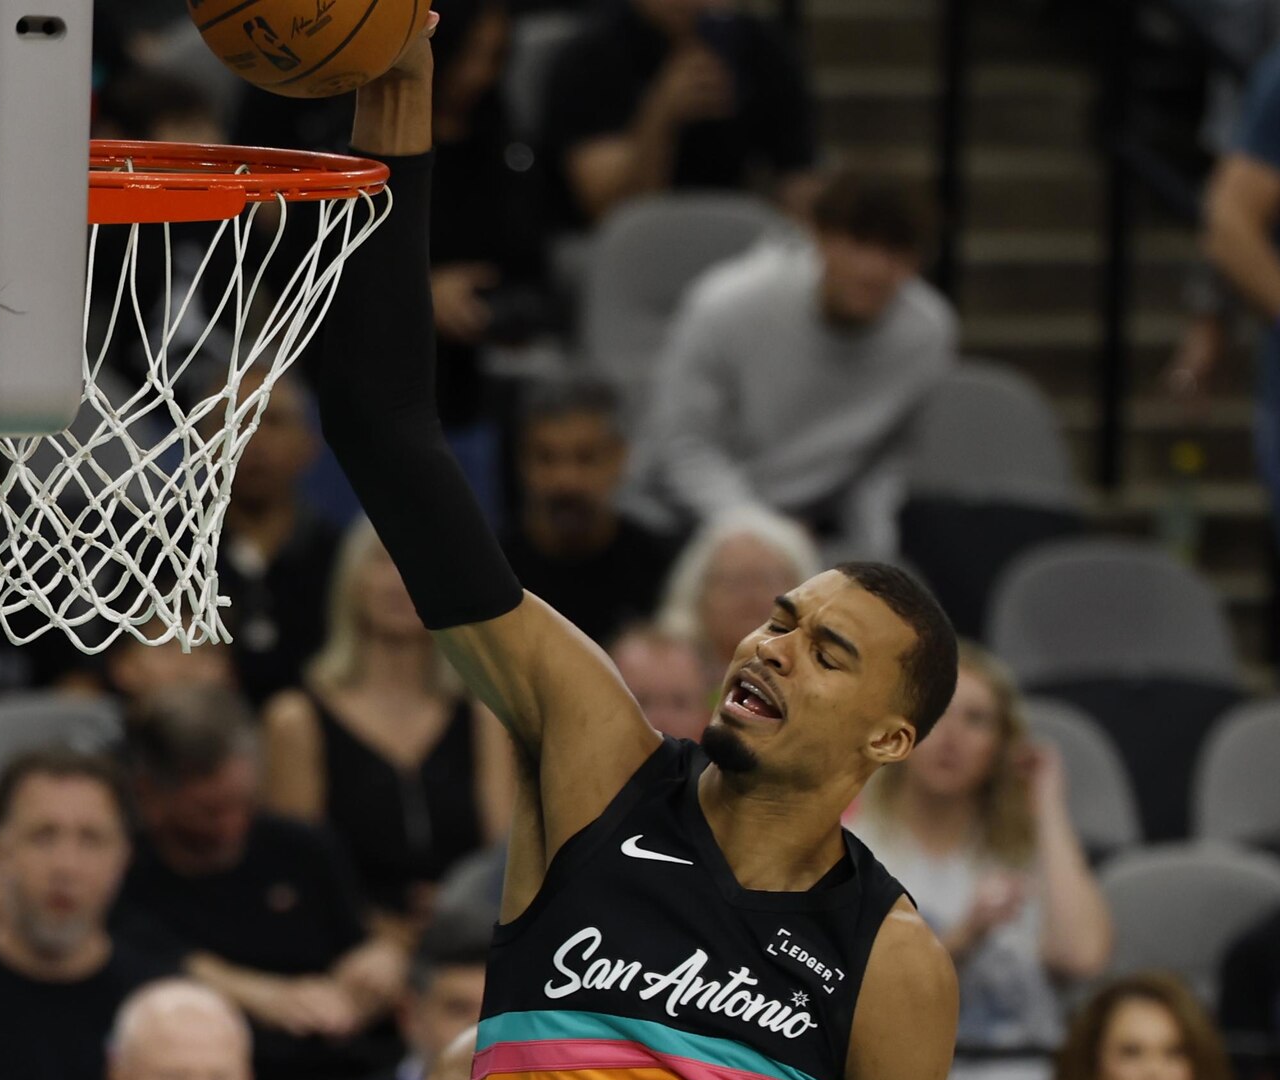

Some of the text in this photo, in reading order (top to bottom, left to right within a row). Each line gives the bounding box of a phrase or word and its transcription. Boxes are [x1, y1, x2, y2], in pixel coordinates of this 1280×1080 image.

[544, 926, 818, 1039] San Antonio
[779, 940, 833, 982] LEDGER
